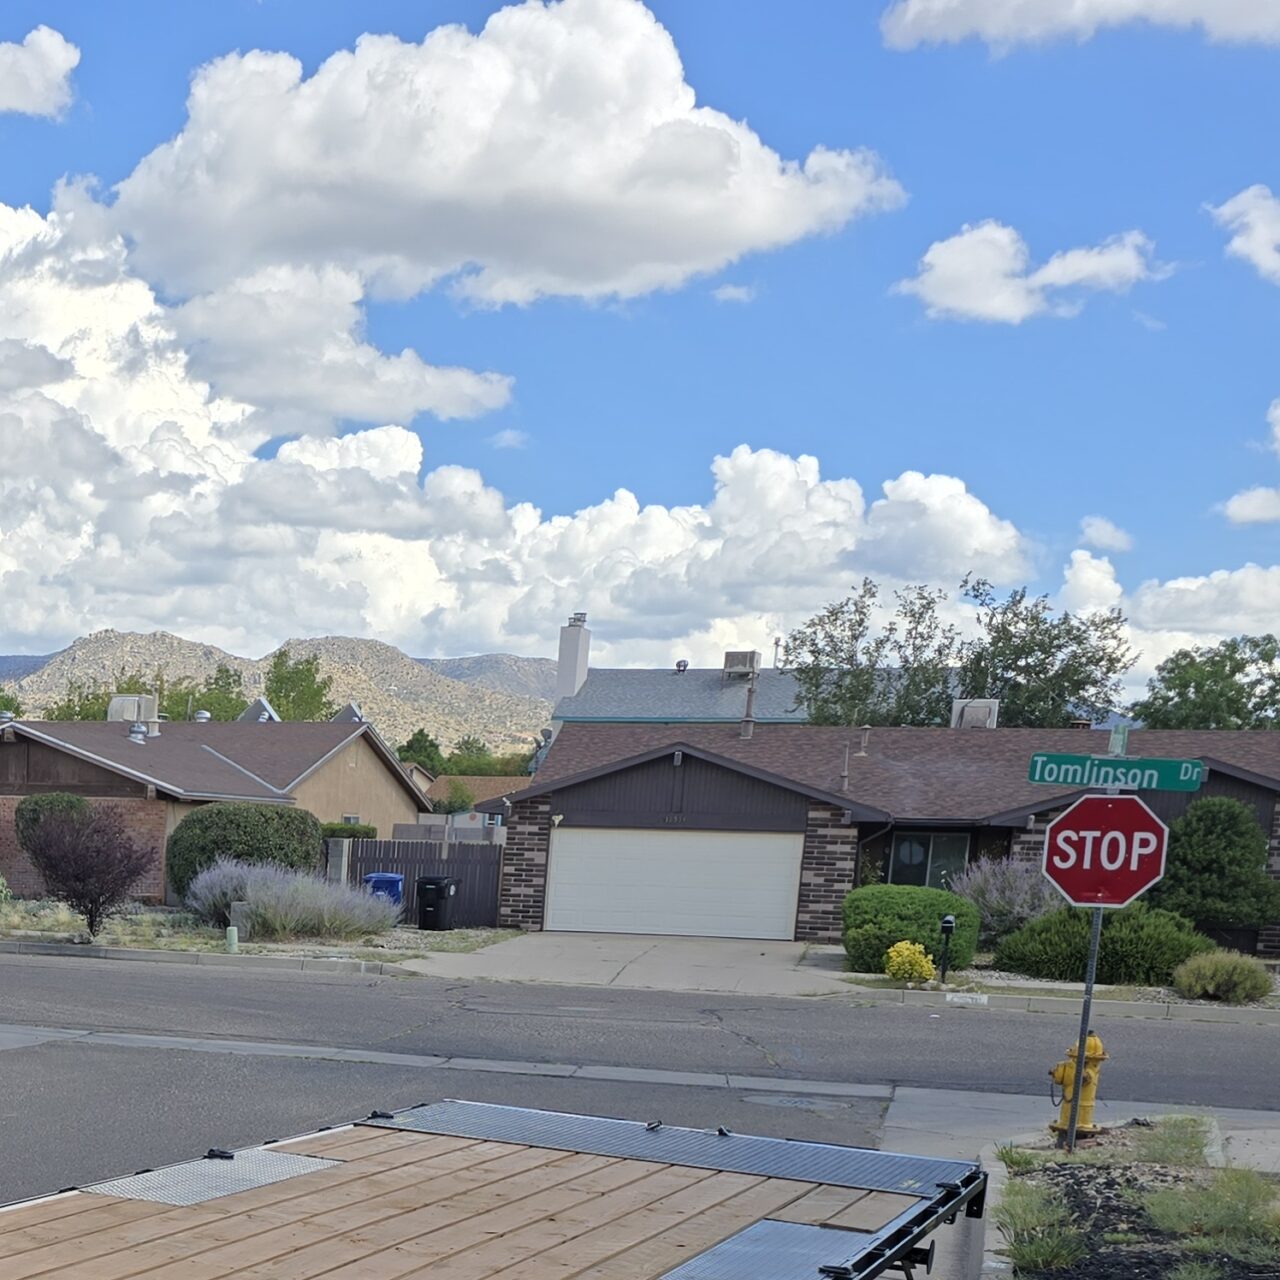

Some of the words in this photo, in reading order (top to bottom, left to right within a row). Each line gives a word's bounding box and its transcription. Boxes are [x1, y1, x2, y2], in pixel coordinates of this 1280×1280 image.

[1032, 756, 1158, 788] Tomlinson
[1179, 763, 1201, 781] Dr
[1053, 830, 1158, 871] STOP
